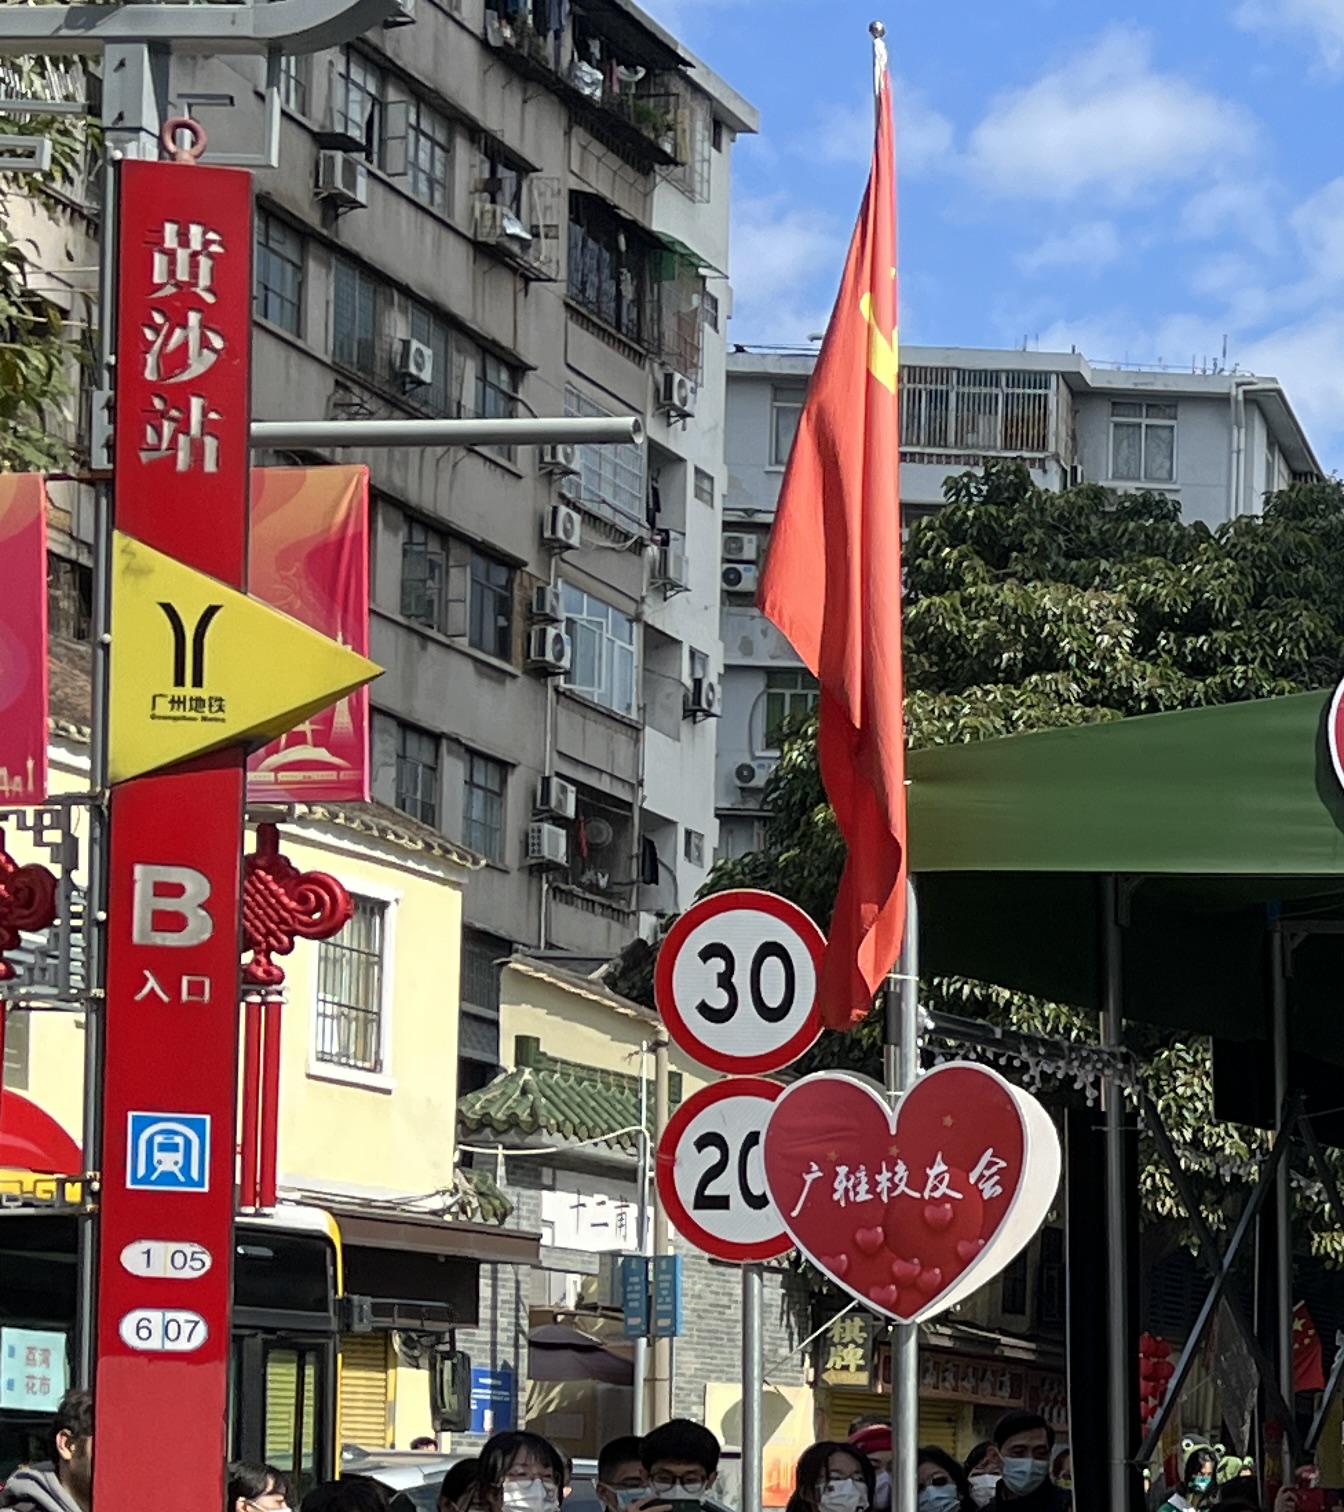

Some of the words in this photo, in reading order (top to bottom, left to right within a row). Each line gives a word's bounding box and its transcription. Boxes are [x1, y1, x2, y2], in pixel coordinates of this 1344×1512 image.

[139, 220, 226, 474] 黄沙站
[150, 693, 226, 714] 广州地铁
[131, 863, 214, 948] B
[134, 969, 211, 1003] 入口
[696, 940, 796, 1025] 30
[790, 1148, 1007, 1218] 广雅校友会
[164, 1318, 201, 1343] 07
[825, 1317, 868, 1373] 棋牌
